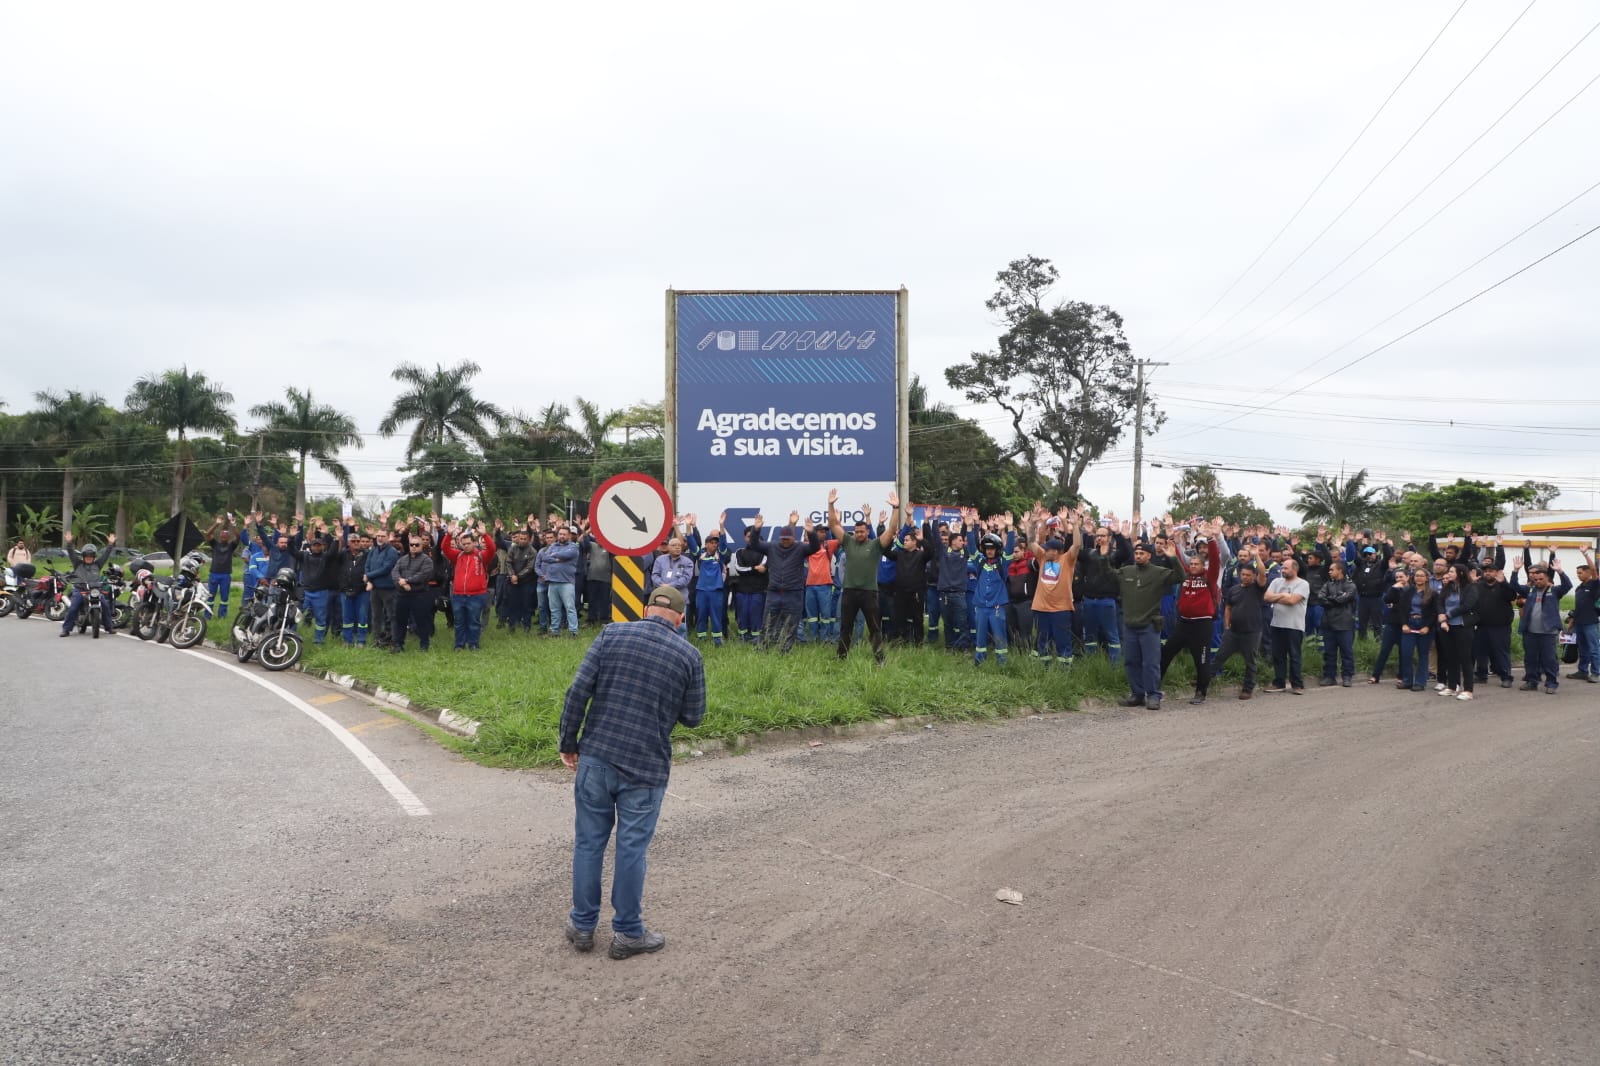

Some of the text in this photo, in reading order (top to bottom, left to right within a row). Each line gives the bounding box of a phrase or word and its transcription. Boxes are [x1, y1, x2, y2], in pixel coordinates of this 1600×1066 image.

[697, 408, 876, 437] Agradecemos
[710, 432, 864, 456] a sua visita.
